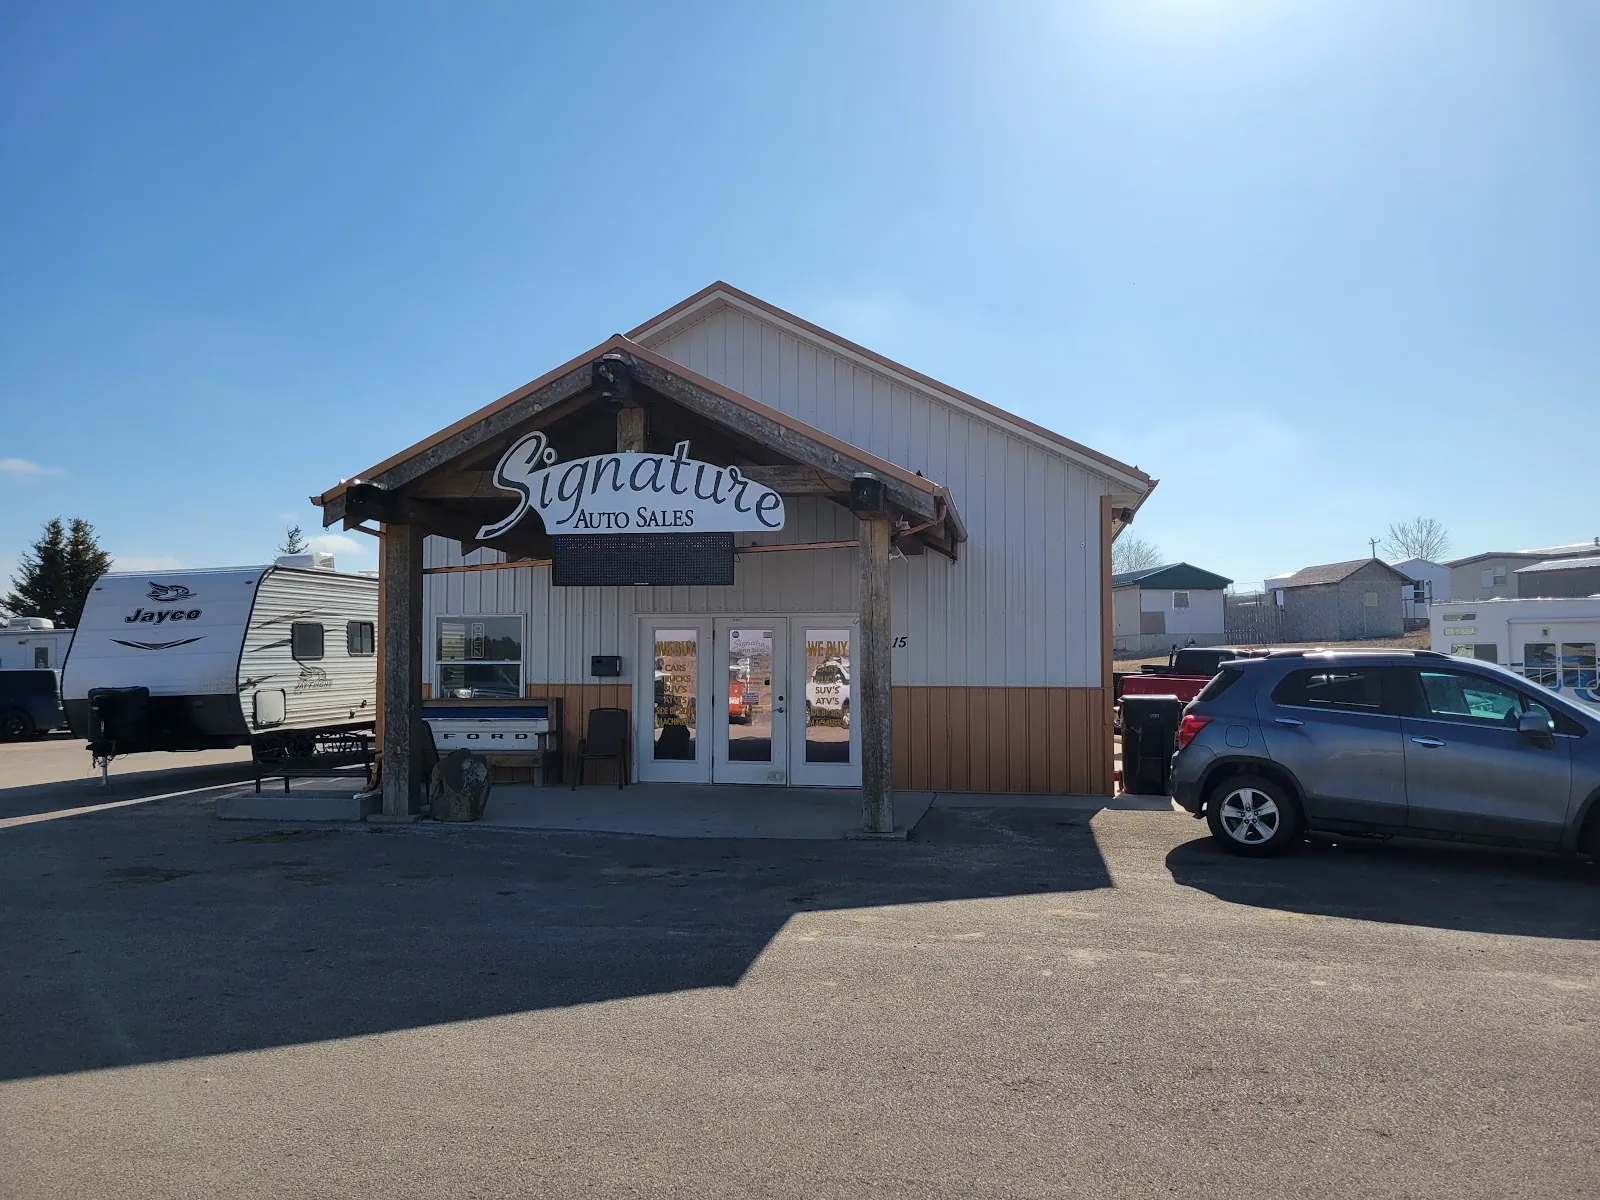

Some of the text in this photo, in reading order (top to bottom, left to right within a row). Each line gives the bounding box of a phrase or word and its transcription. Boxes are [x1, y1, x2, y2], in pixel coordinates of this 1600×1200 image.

[479, 432, 783, 539] Signature
[573, 507, 694, 529] AUTO SALES
[125, 608, 202, 625] Jayco
[473, 624, 482, 657] OPEN
[656, 641, 694, 656] WE BUY
[808, 641, 848, 656] WE BUY
